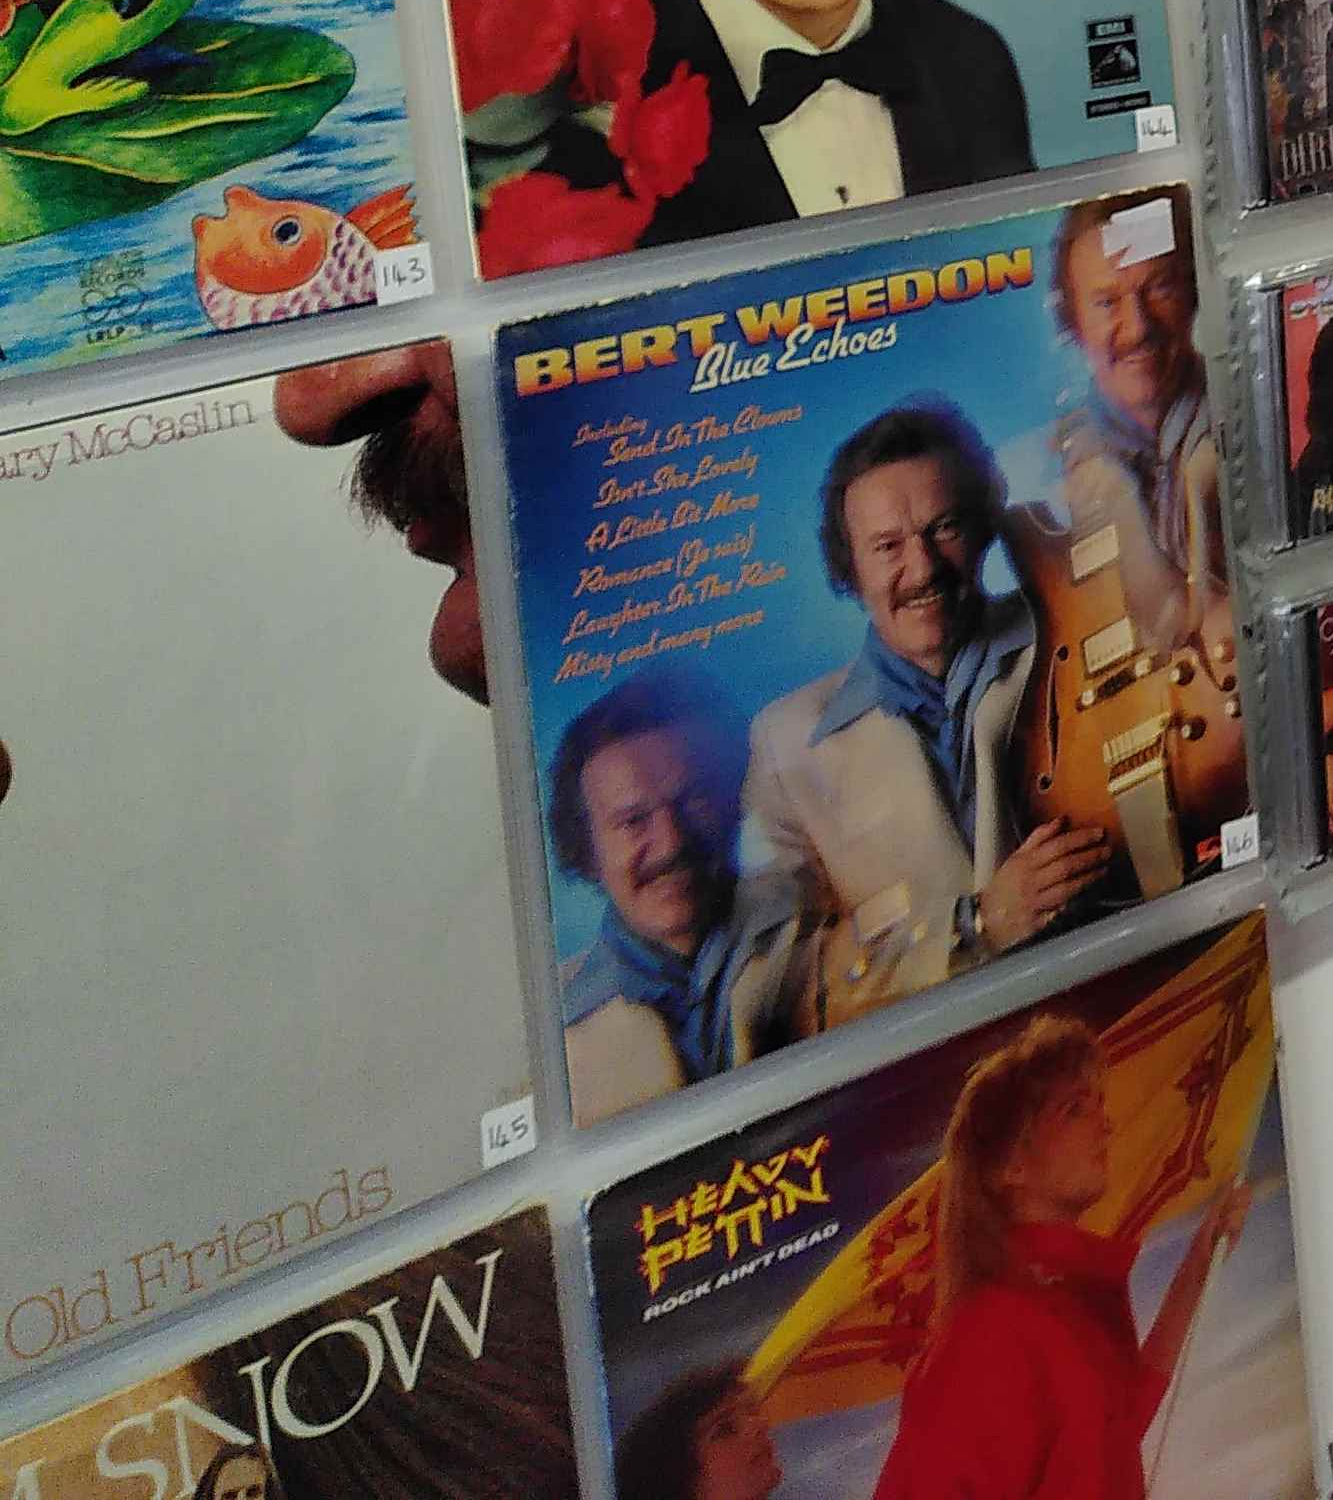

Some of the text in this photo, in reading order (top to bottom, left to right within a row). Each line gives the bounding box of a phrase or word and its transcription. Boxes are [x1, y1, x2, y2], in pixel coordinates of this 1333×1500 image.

[382, 257, 426, 288] 143
[514, 247, 1033, 397] BERT WEEDON
[689, 322, 898, 393] Blue Echoes
[63, 400, 256, 466] McCaslin
[602, 429, 661, 467] Send
[653, 422, 692, 453] In
[692, 415, 729, 444] The
[647, 464, 690, 496] She
[689, 446, 759, 488] Lovely
[585, 521, 609, 551] A
[694, 573, 733, 603] The
[617, 628, 661, 664] and
[660, 627, 712, 650] many
[488, 1114, 529, 1150] 145
[634, 1134, 831, 1243] HEAVY
[4, 1164, 396, 1361] Old Friends
[639, 1165, 832, 1296] PETTIN
[642, 1221, 840, 1323] ROCK AIN'T DEAD
[97, 1246, 504, 1500] SNOW
